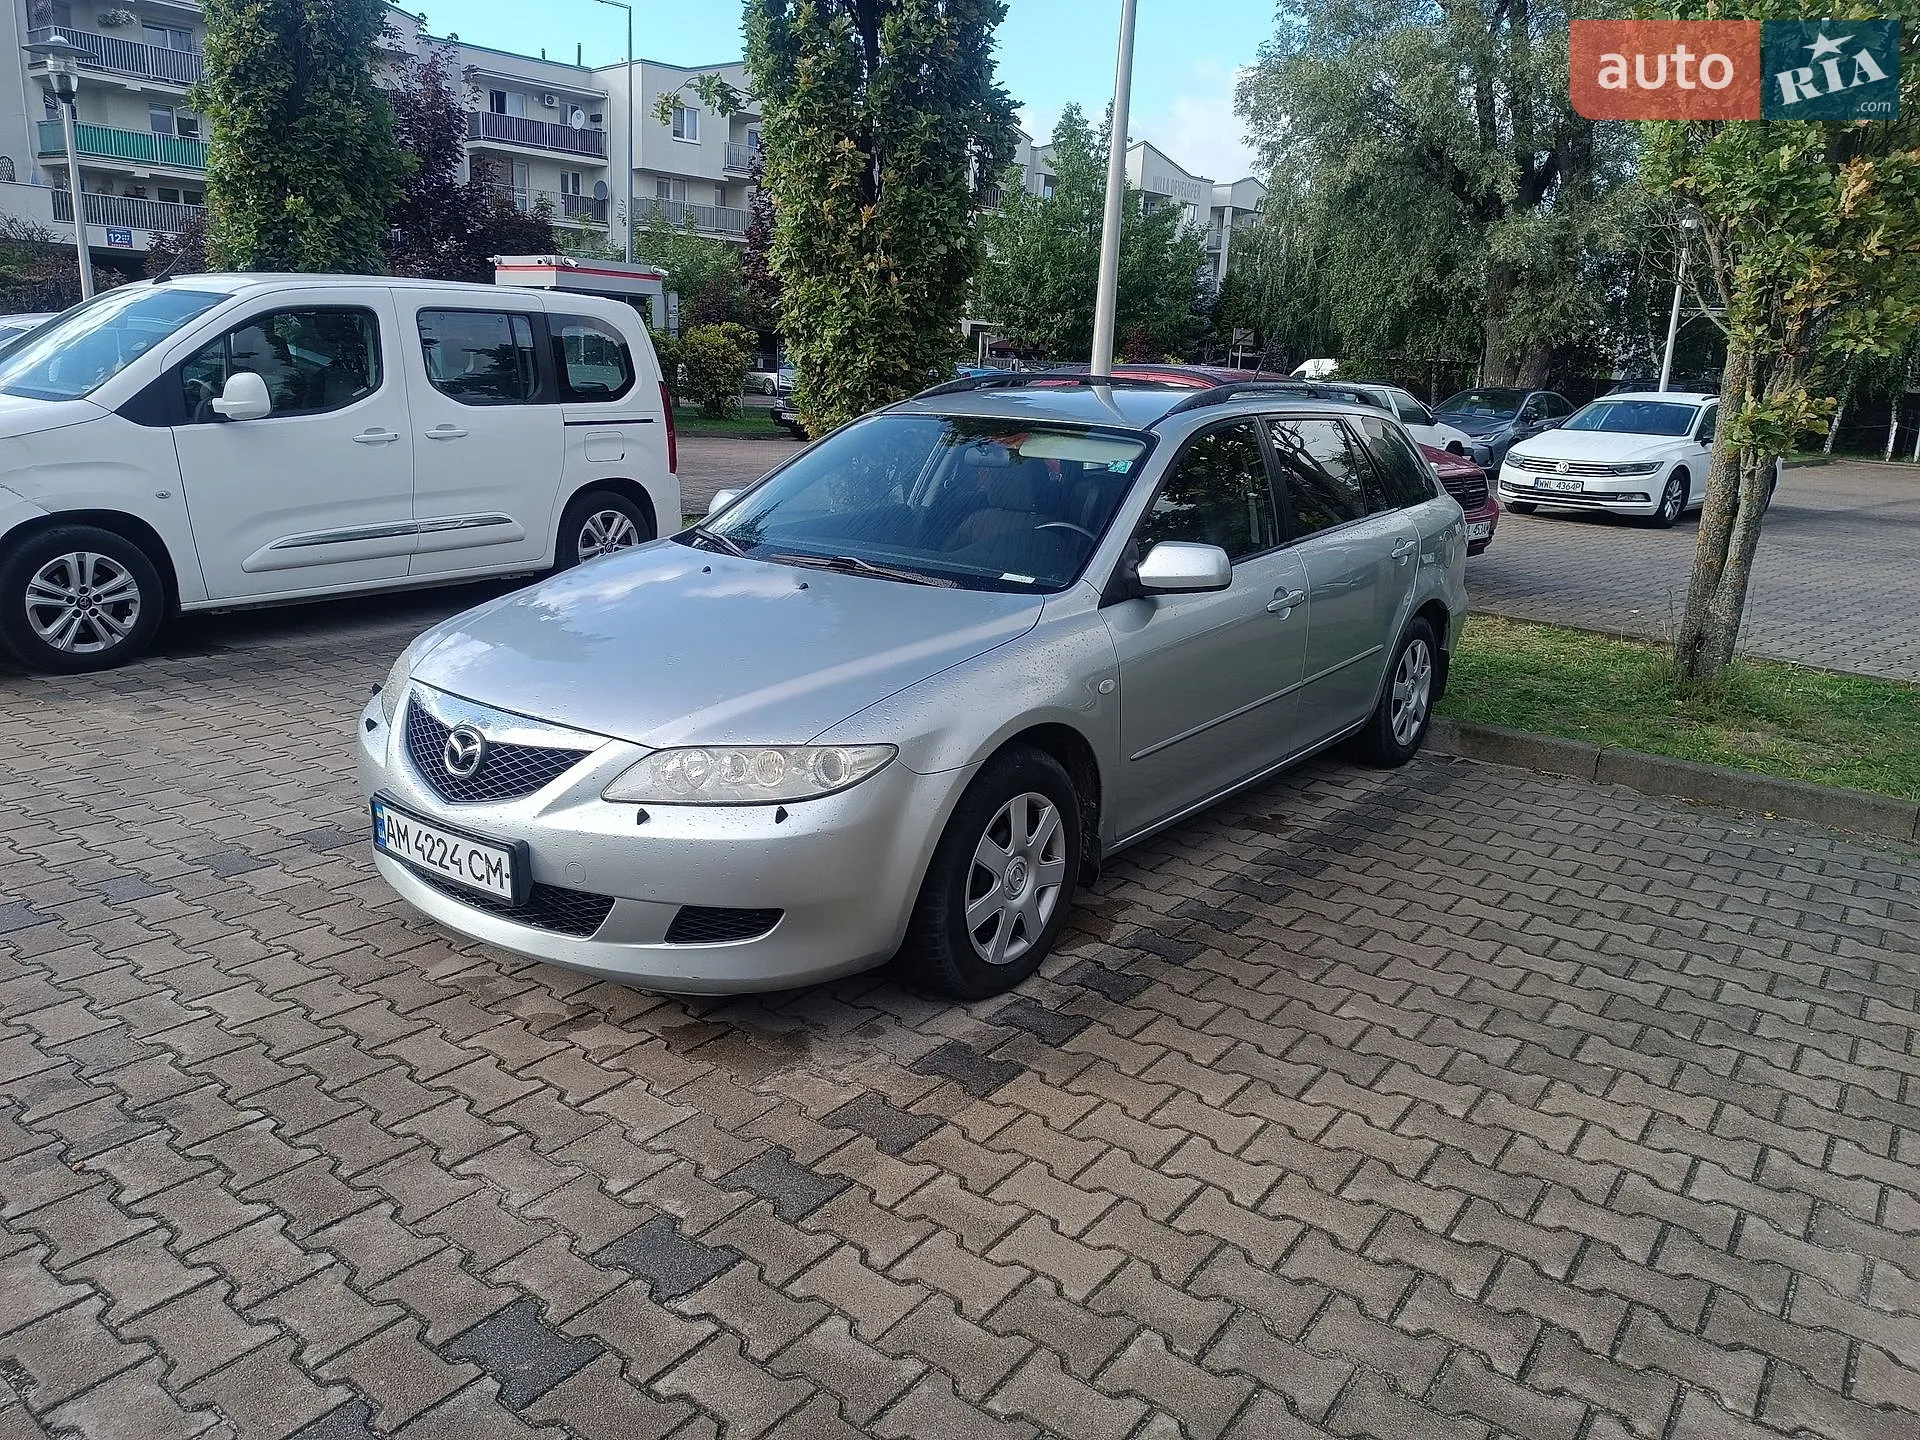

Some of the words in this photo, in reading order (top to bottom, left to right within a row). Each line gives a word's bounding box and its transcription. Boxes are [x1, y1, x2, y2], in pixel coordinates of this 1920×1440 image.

[386, 814, 411, 855] AM
[414, 829, 464, 876] 4224
[467, 849, 505, 890] CM
